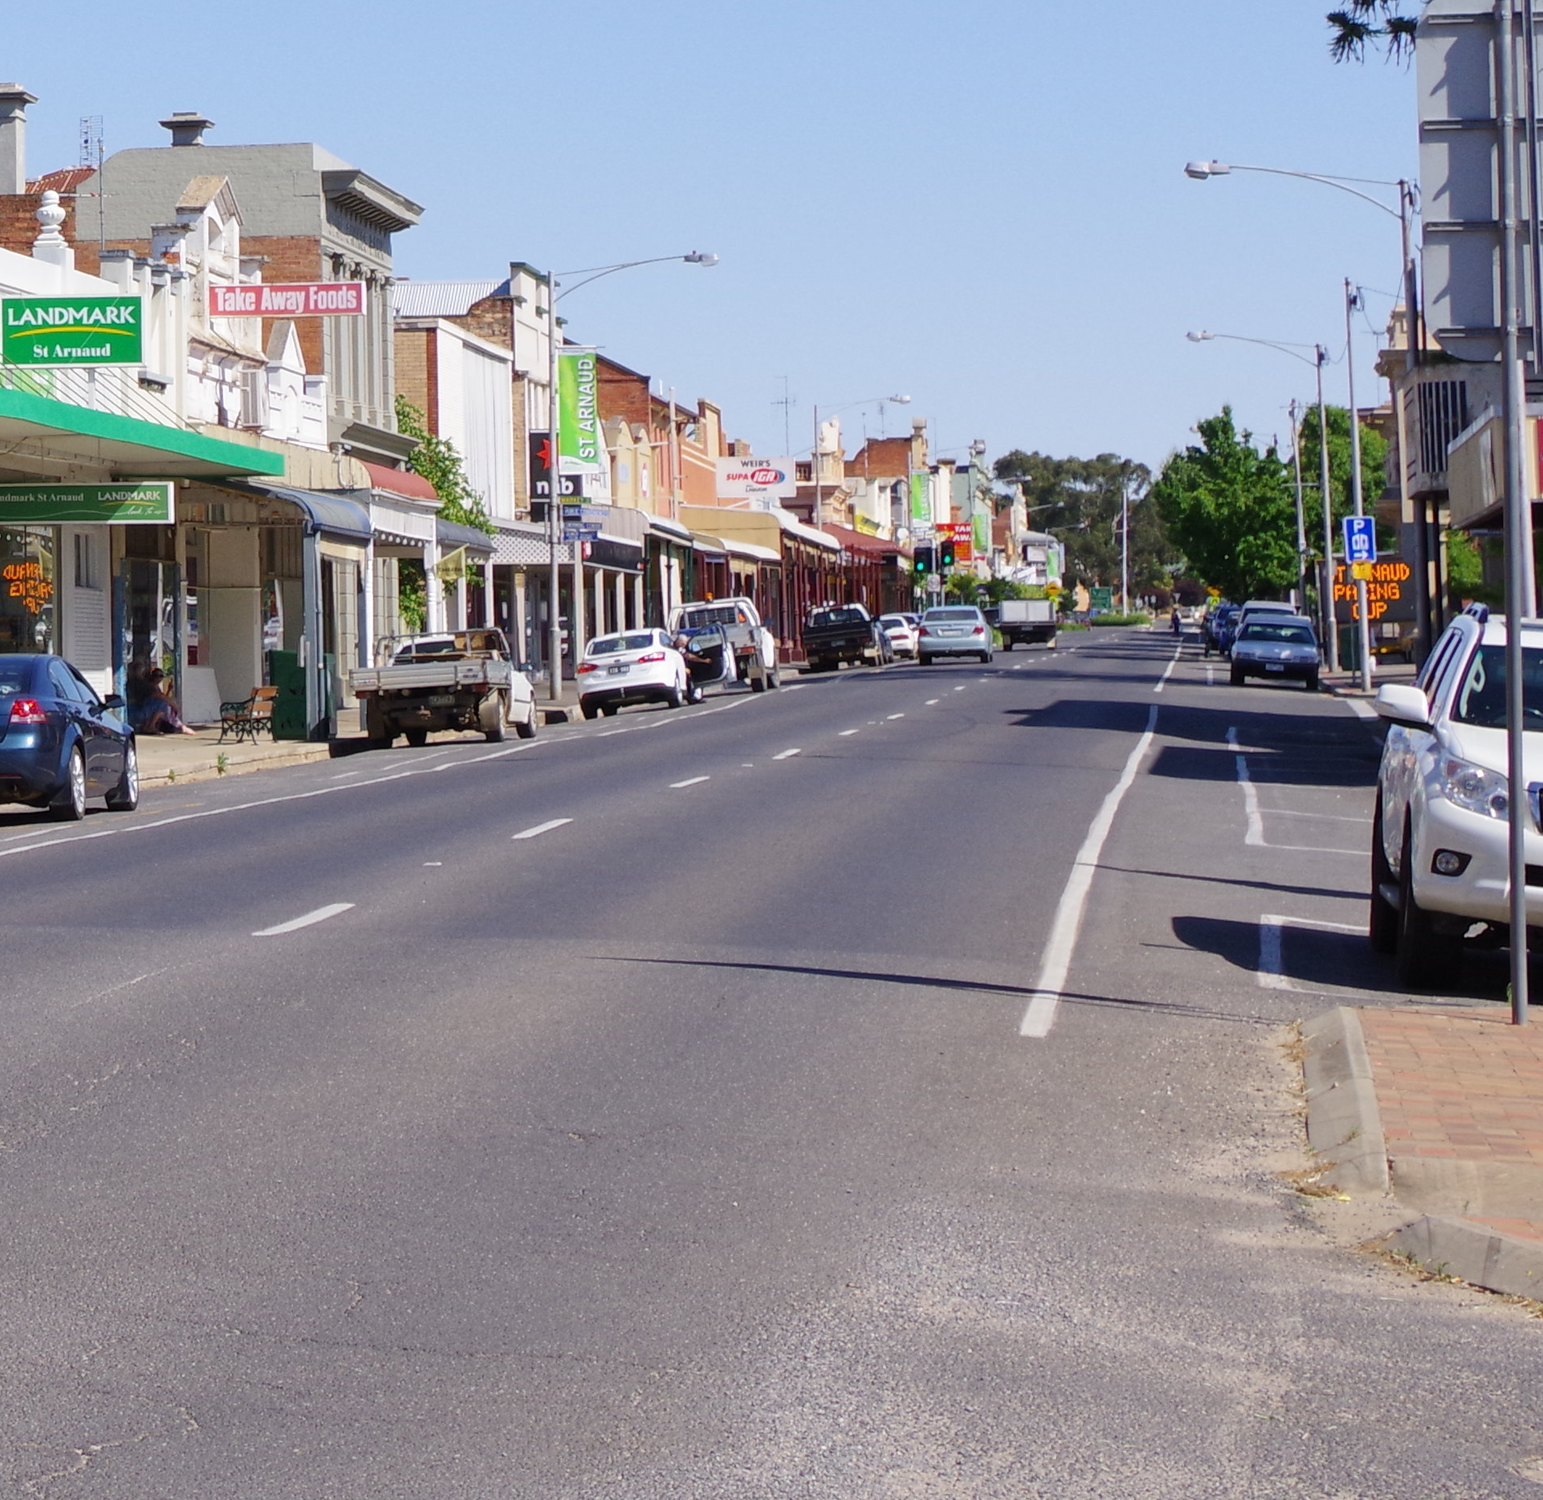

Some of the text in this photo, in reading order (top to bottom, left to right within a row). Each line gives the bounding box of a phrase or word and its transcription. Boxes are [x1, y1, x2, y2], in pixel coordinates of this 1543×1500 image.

[215, 285, 357, 313] Take Away Foods
[7, 305, 137, 326] LANDMARK
[33, 343, 112, 358] St Arnaud
[577, 358, 596, 459] ST ARNAUD
[740, 459, 771, 468] WEIR'S
[536, 476, 575, 495] nb
[726, 470, 776, 483] SUPA IGA
[37, 493, 49, 502] St
[50, 492, 84, 503] Arnaud
[97, 490, 161, 501] LANDMARK
[1353, 519, 1365, 534] P
[1365, 563, 1411, 582] NAUD
[1334, 582, 1400, 601] PAING
